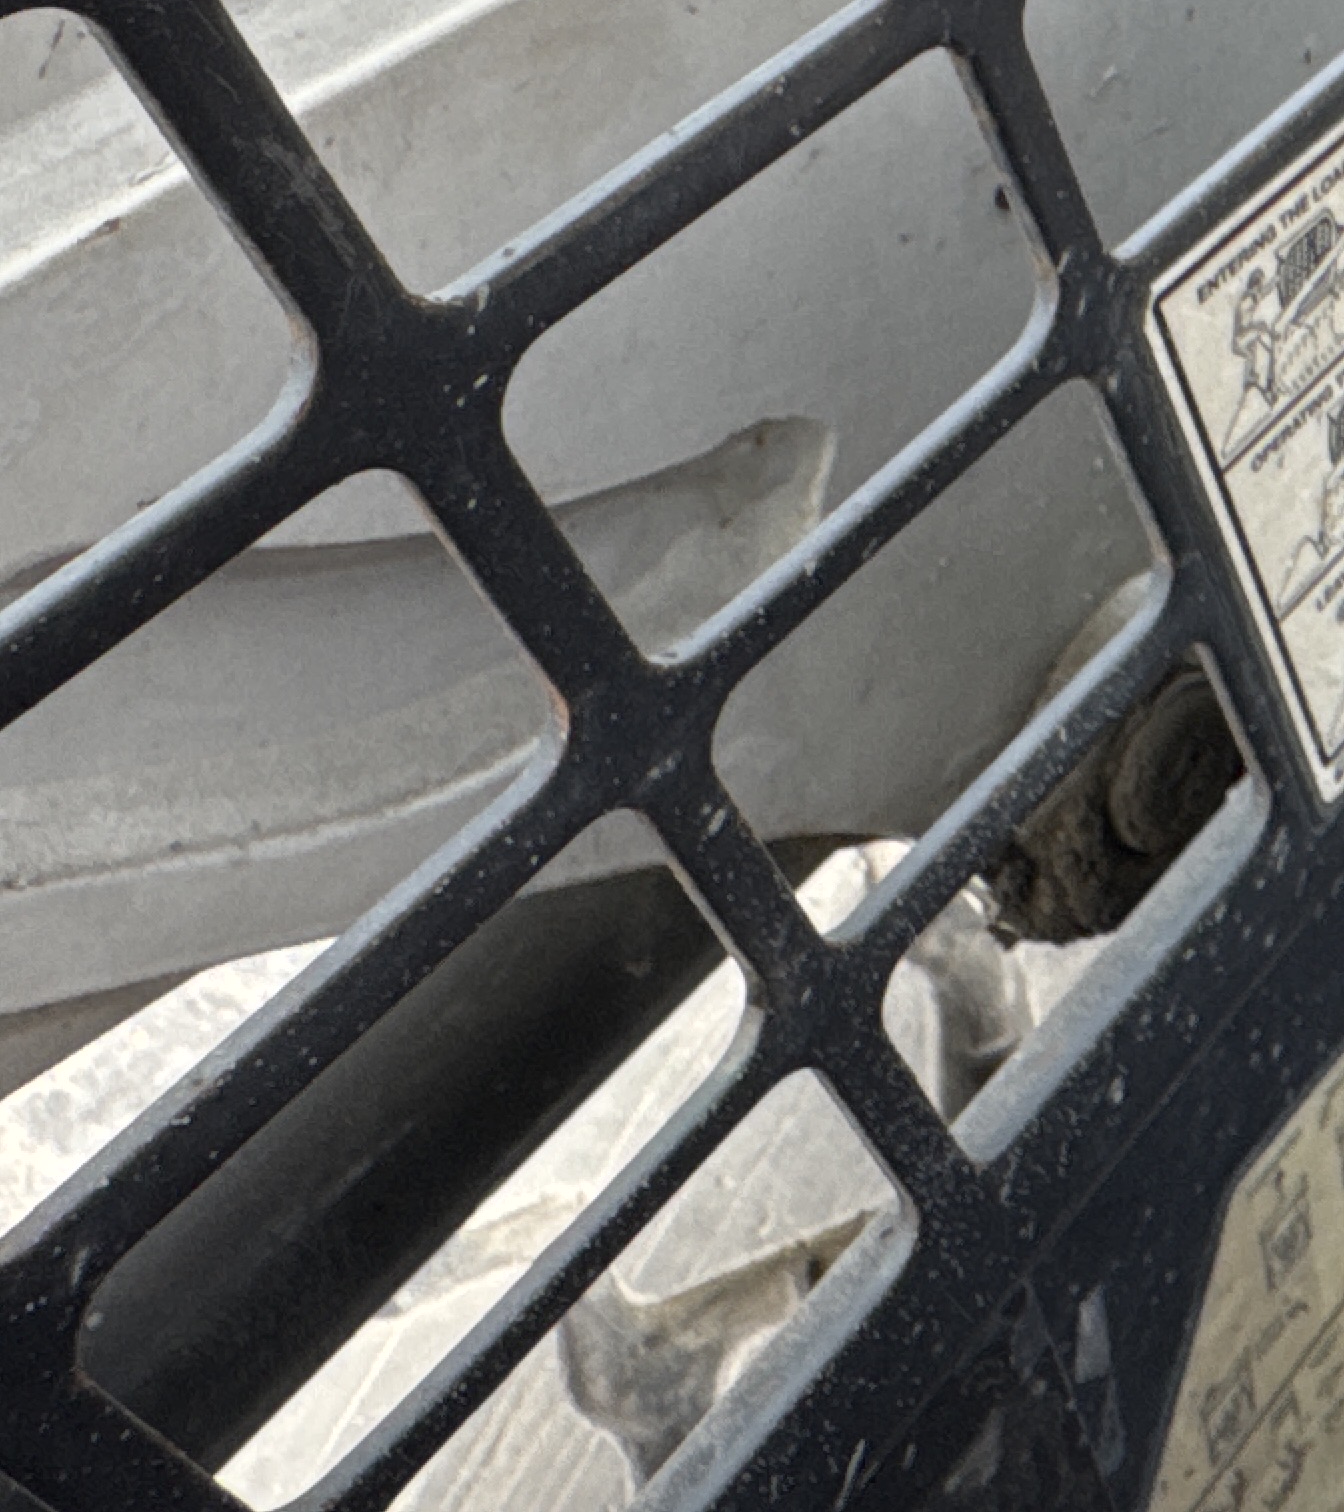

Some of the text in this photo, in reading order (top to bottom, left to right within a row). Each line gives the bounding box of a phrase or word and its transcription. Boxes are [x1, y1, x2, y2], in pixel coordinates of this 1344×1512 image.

[1192, 218, 1279, 308] ENTERING
[1277, 190, 1312, 234] THE
[1247, 378, 1335, 478] OPERATING
